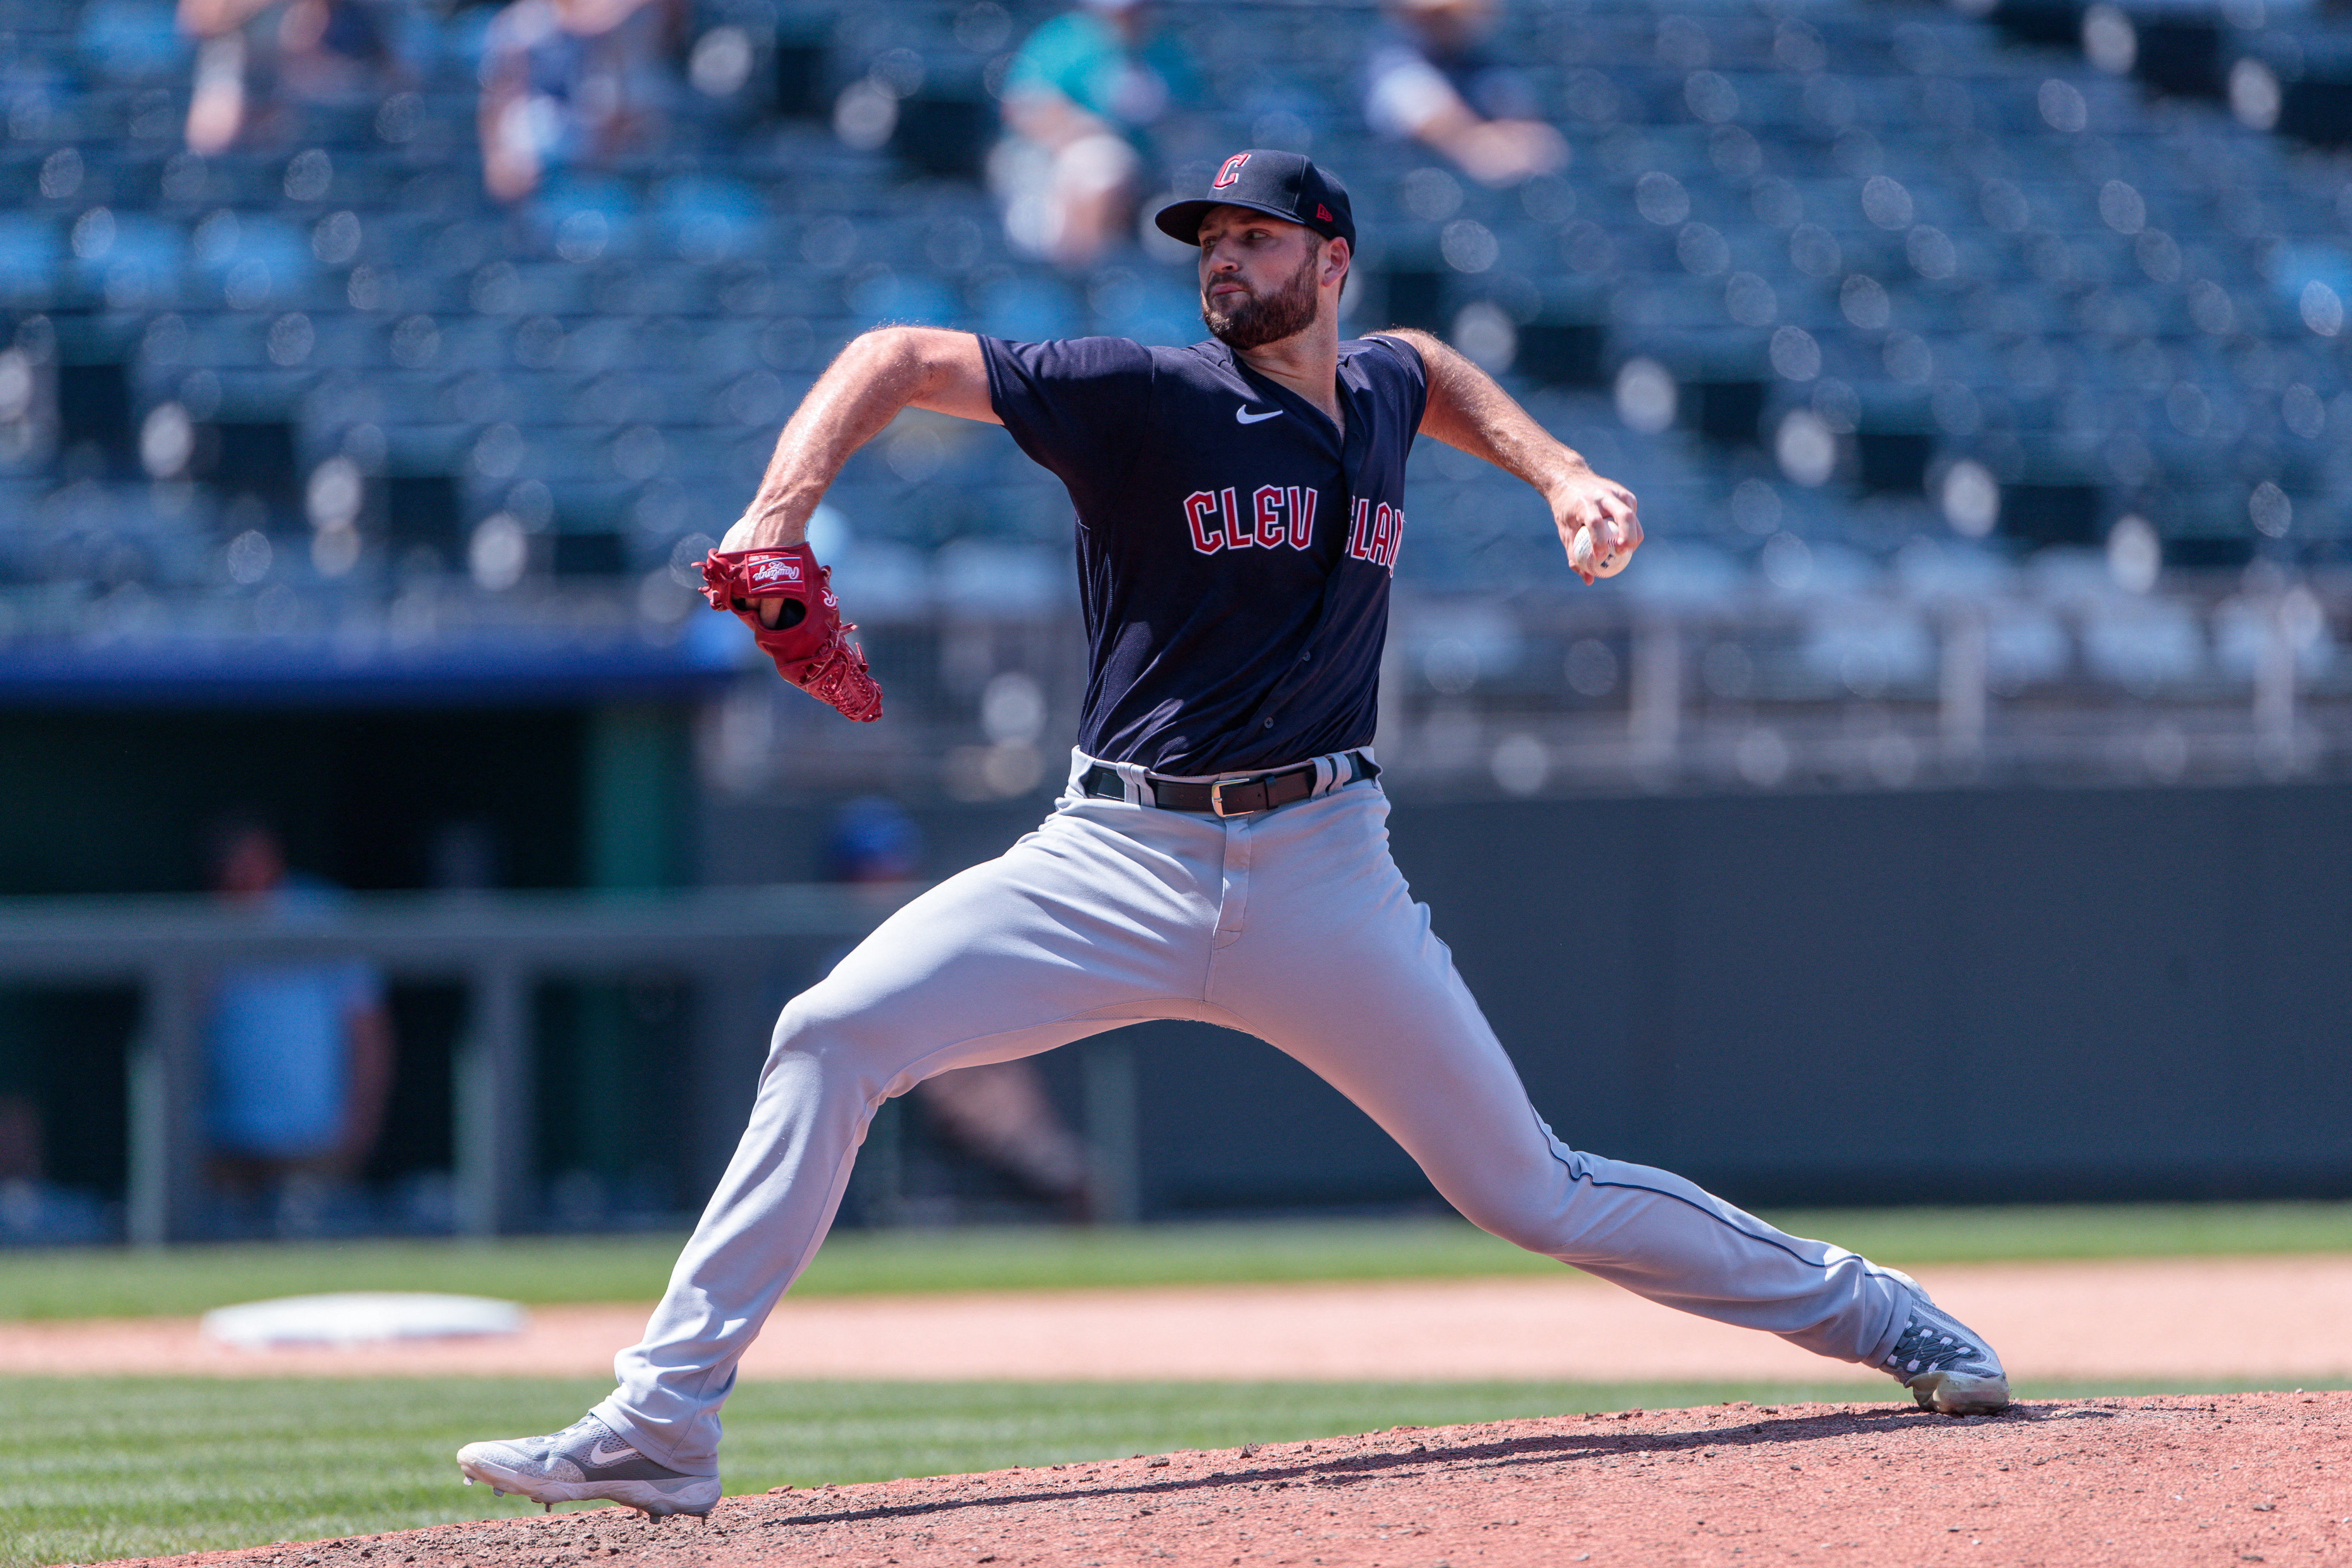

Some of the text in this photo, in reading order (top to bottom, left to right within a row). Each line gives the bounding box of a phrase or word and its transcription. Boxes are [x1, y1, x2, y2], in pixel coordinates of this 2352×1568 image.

[1213, 153, 1251, 190] C
[753, 565, 799, 581] Rawlings
[821, 590, 836, 606] R
